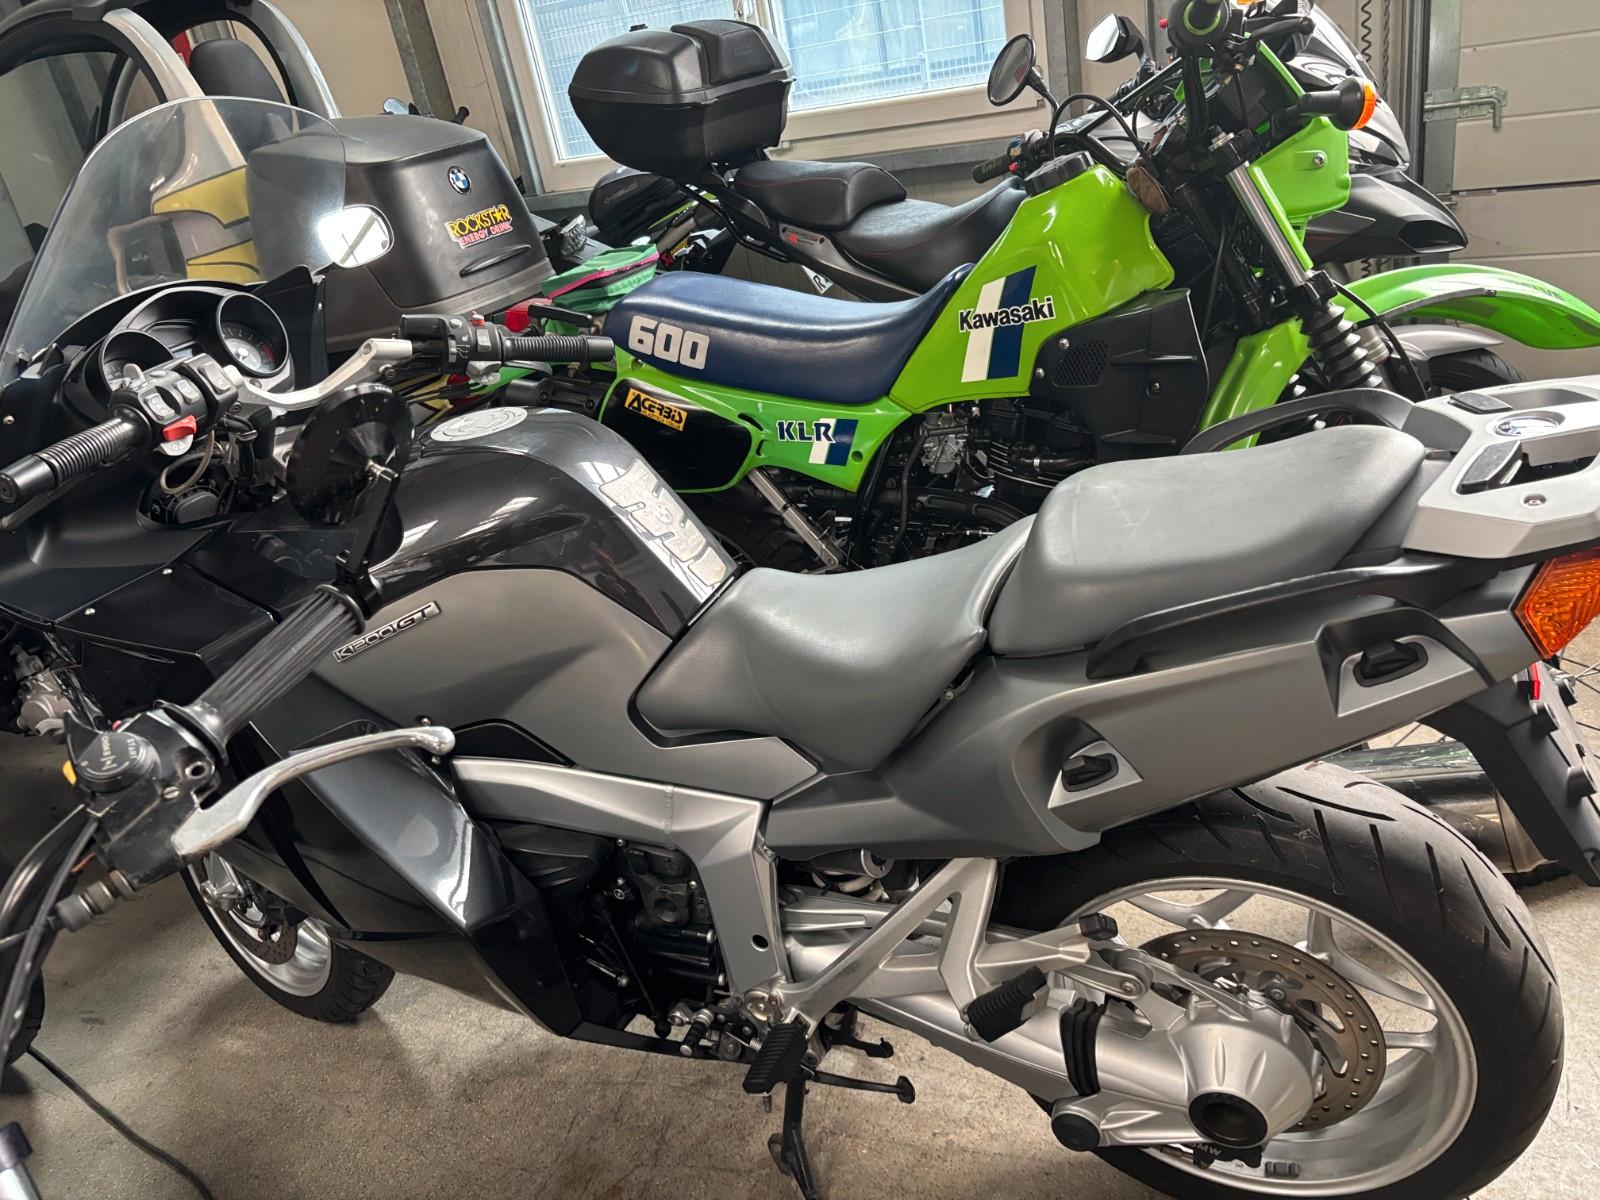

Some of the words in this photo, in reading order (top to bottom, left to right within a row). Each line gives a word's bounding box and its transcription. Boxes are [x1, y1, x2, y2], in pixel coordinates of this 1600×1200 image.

[459, 228, 490, 246] ENERGY
[959, 296, 1055, 332] Kawasaki
[628, 315, 710, 370] 600
[776, 420, 836, 443] KLR
